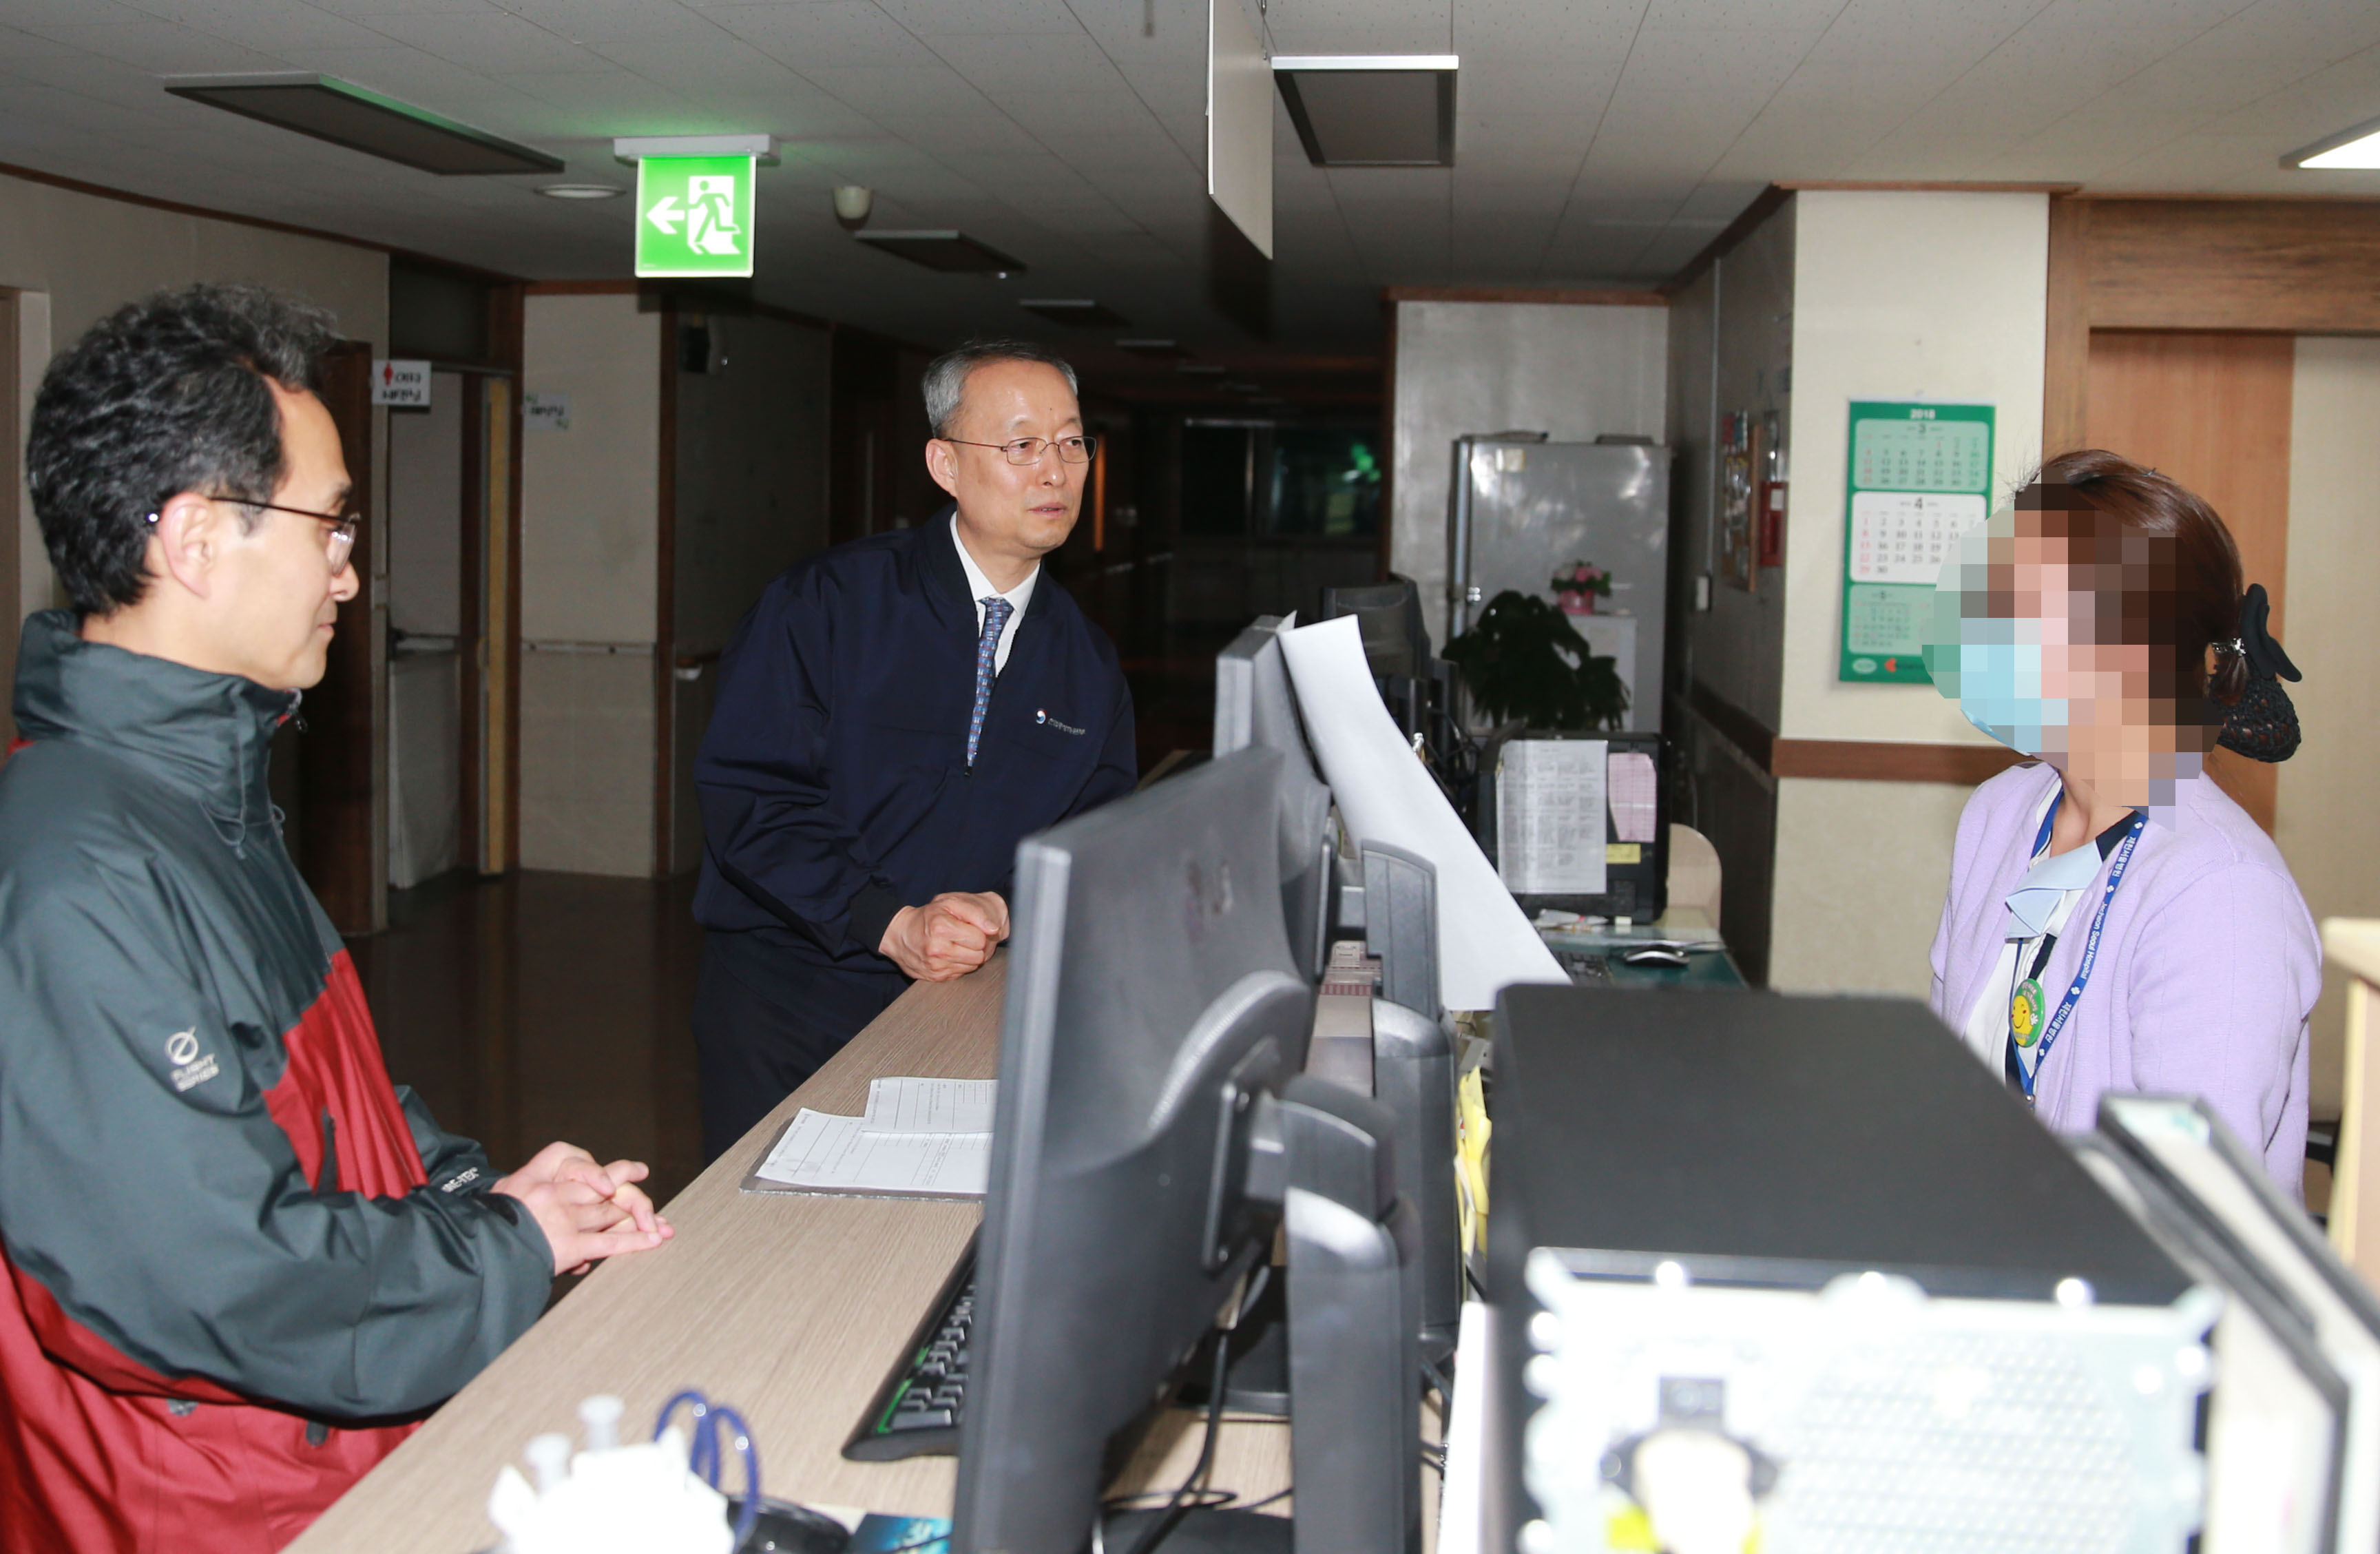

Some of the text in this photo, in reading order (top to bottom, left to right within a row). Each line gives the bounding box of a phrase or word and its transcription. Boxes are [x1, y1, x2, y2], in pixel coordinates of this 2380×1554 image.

[1910, 408, 1936, 419] 2018
[1914, 497, 1923, 510] 4
[2080, 901, 2107, 980] Jecheon Seoul Hospital
[2045, 1002, 2072, 1044] 제천서울병원
